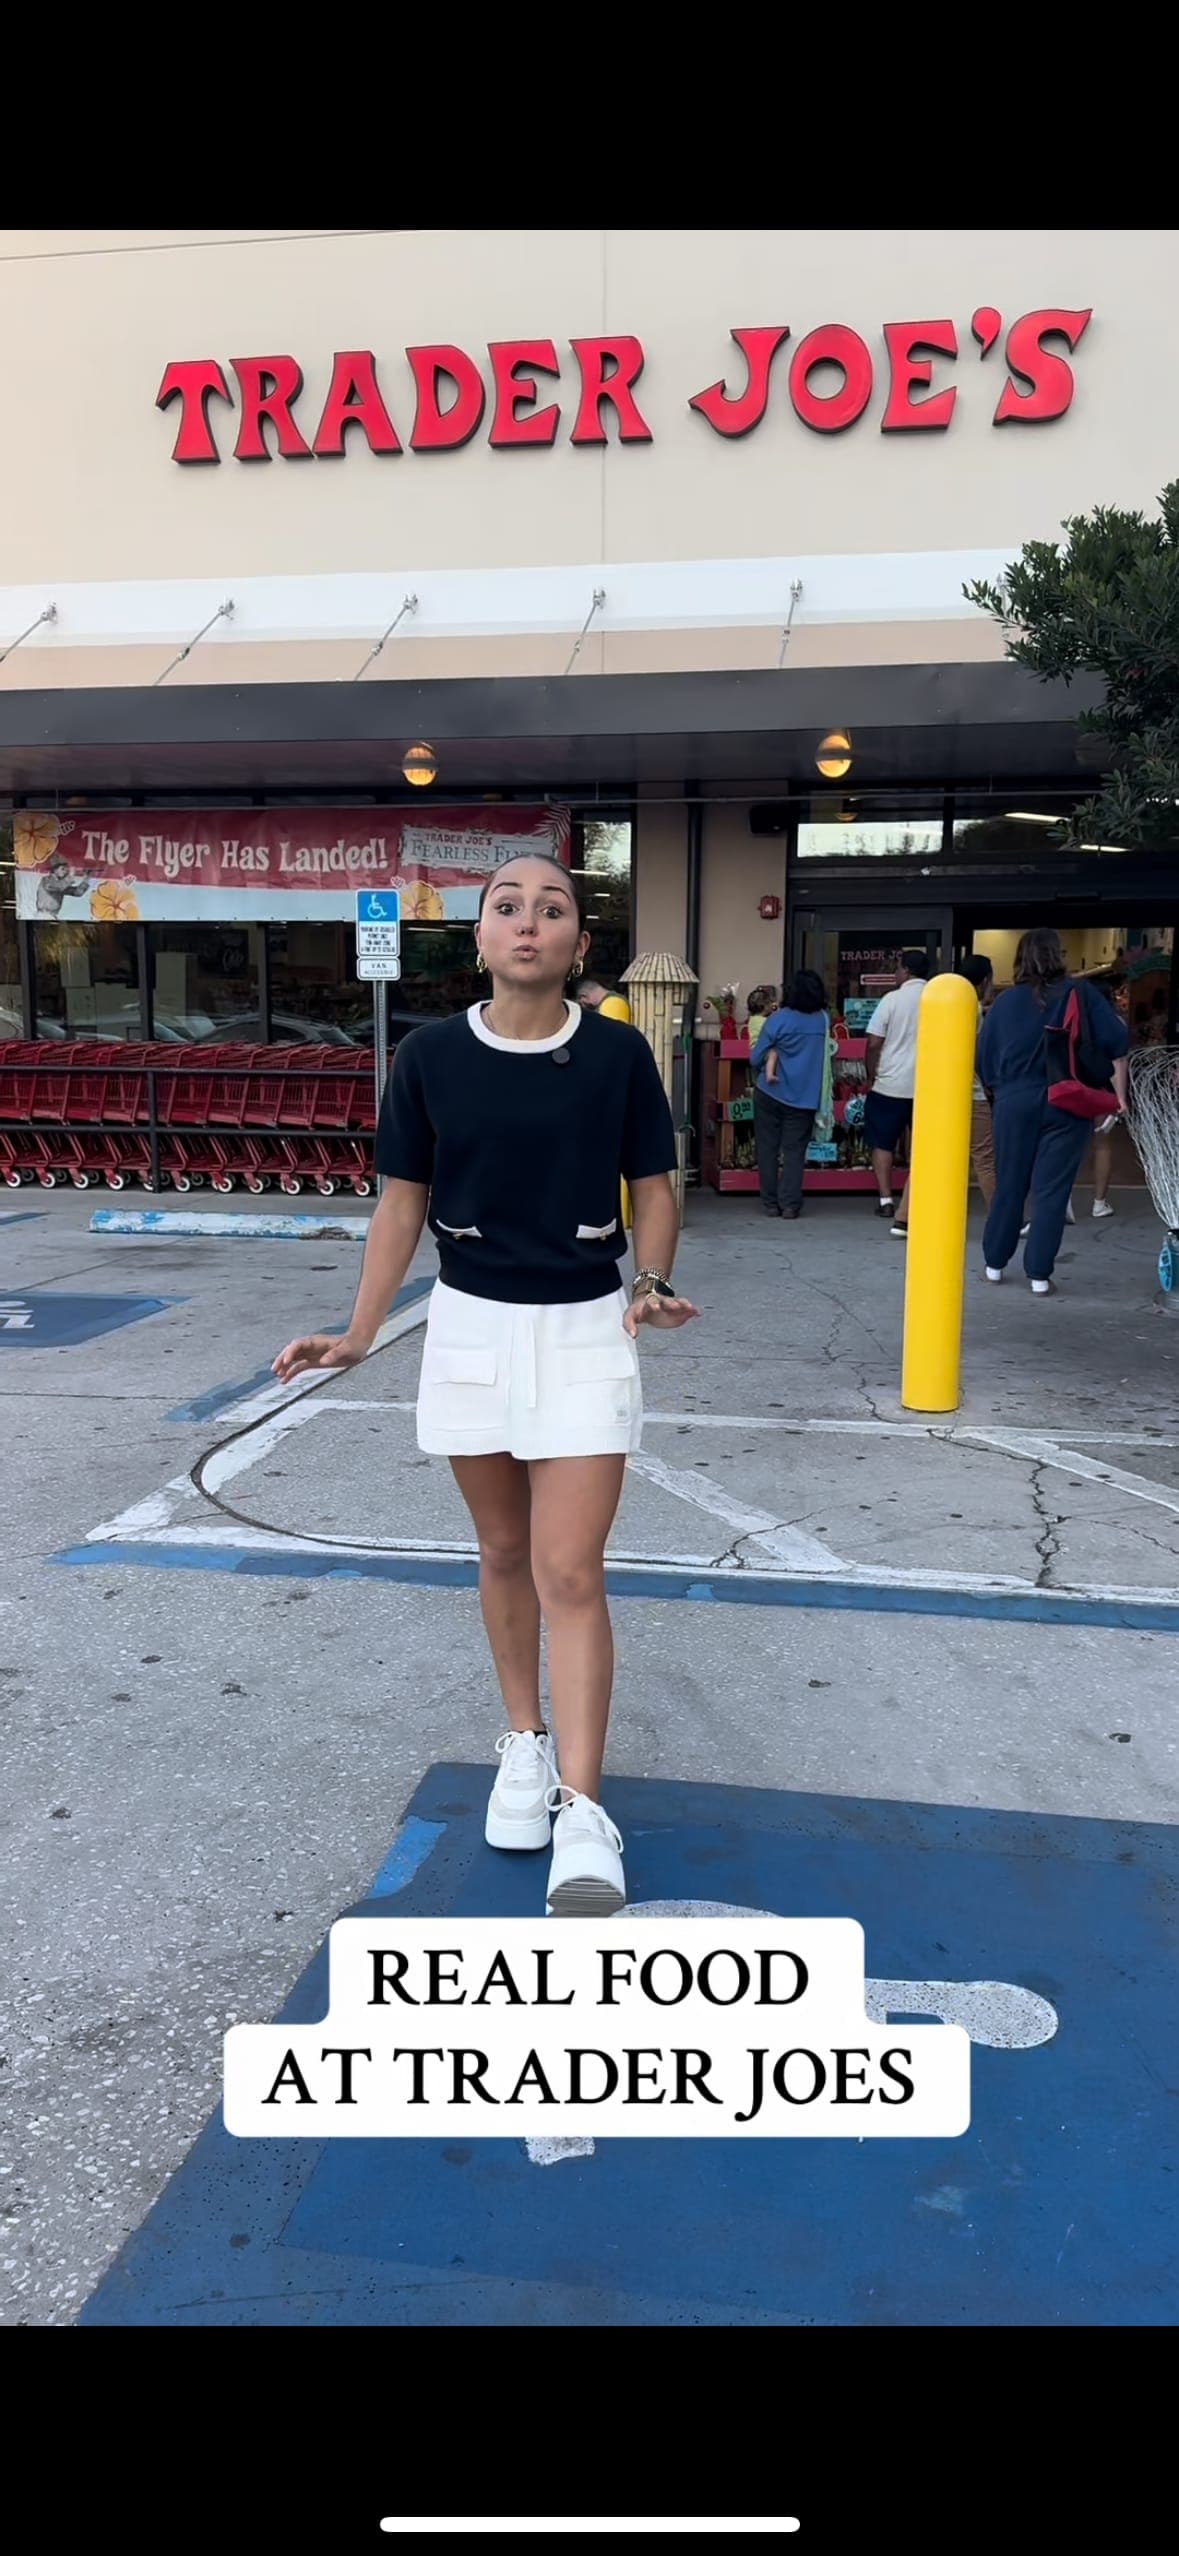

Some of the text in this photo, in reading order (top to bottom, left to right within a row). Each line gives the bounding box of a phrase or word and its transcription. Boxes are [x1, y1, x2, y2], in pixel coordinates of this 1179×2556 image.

[157, 308, 1091, 466] TRADER JOE'S
[425, 833, 493, 846] TRADER JOE'S
[81, 830, 389, 878] The Flyer Has Landed!
[411, 840, 489, 862] FEARLESS
[841, 951, 885, 960] TRADER
